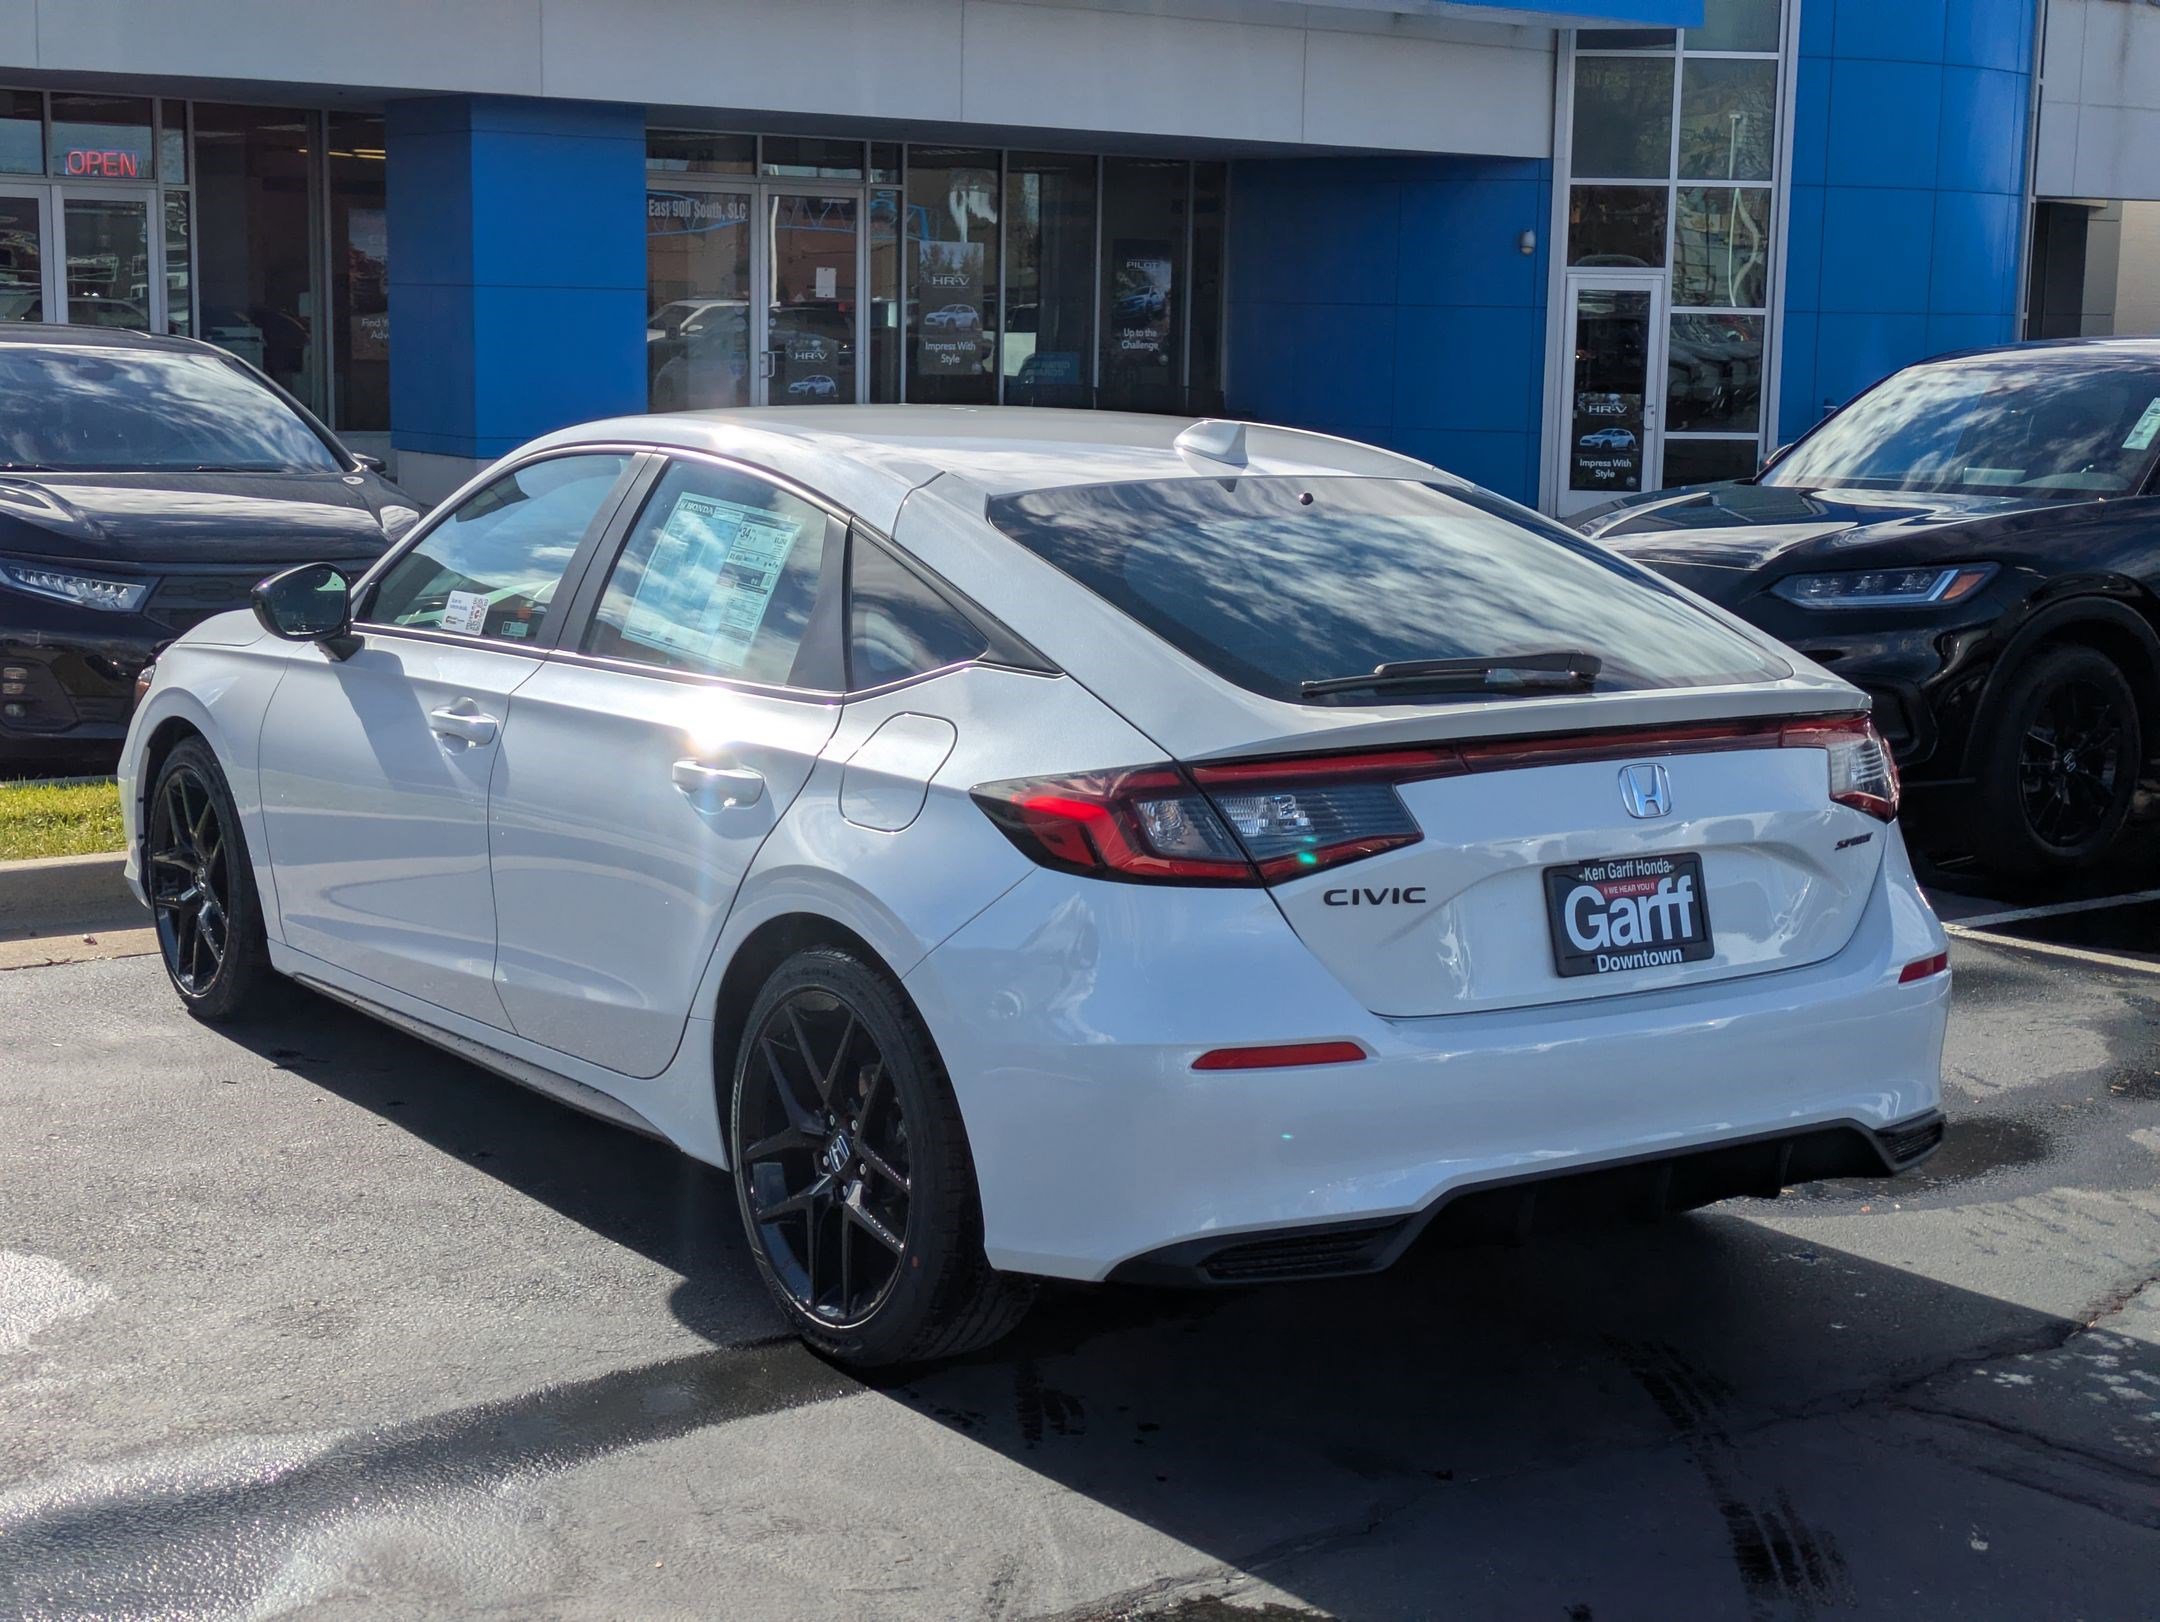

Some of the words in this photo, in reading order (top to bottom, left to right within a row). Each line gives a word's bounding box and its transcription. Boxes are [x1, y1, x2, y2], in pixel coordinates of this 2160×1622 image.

[67, 150, 137, 177] OPEN
[648, 199, 669, 217] East
[728, 202, 746, 219] SLC
[1126, 261, 1158, 269] PILOT
[1123, 328, 1135, 339] Up
[1136, 328, 1144, 337] to
[1145, 328, 1157, 337] the
[925, 340, 956, 352] Impress
[957, 340, 976, 351] With
[1121, 340, 1159, 351] Challenge
[941, 353, 960, 366] Style
[1579, 458, 1611, 469] Impress
[1612, 458, 1632, 468] With
[1595, 469, 1616, 480] Style
[687, 502, 714, 515] HONDA
[1584, 866, 1606, 882] Ken
[1607, 861, 1634, 880] Garff
[1635, 857, 1670, 876] Honda
[1608, 886, 1619, 894] WE
[1619, 884, 1637, 894] HEAR
[1637, 883, 1650, 893] YOU
[1323, 886, 1427, 906] CIVIC
[1564, 874, 1694, 952] Garff
[1596, 948, 1683, 973] Downtown
